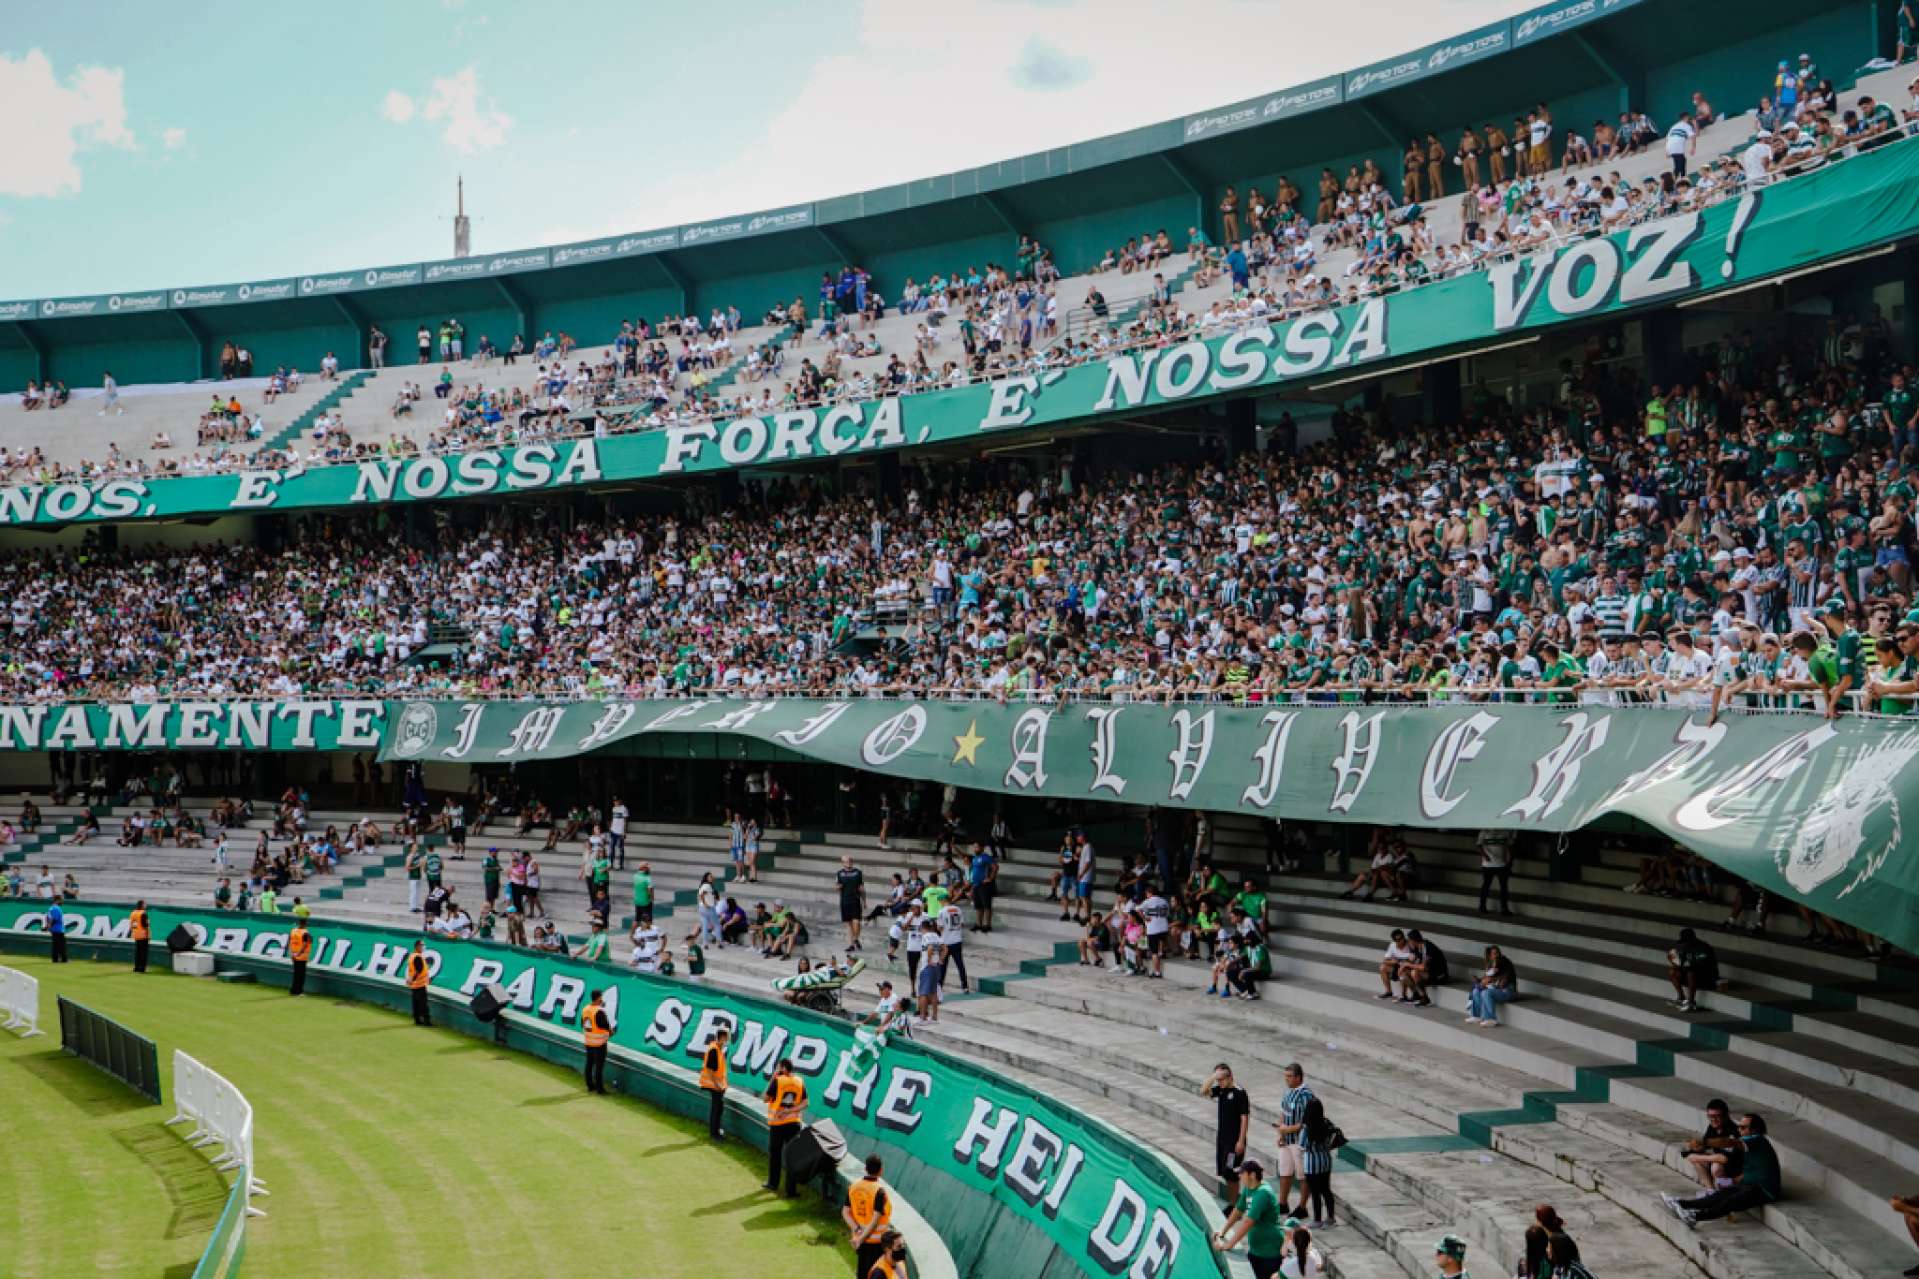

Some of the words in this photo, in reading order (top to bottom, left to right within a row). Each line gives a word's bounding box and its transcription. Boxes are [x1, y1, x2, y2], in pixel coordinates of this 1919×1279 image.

[350, 438, 601, 502] NOSSA
[1093, 298, 1386, 411] NOSSA
[0, 701, 387, 749] NAMENTE
[954, 1096, 1085, 1220] HEI
